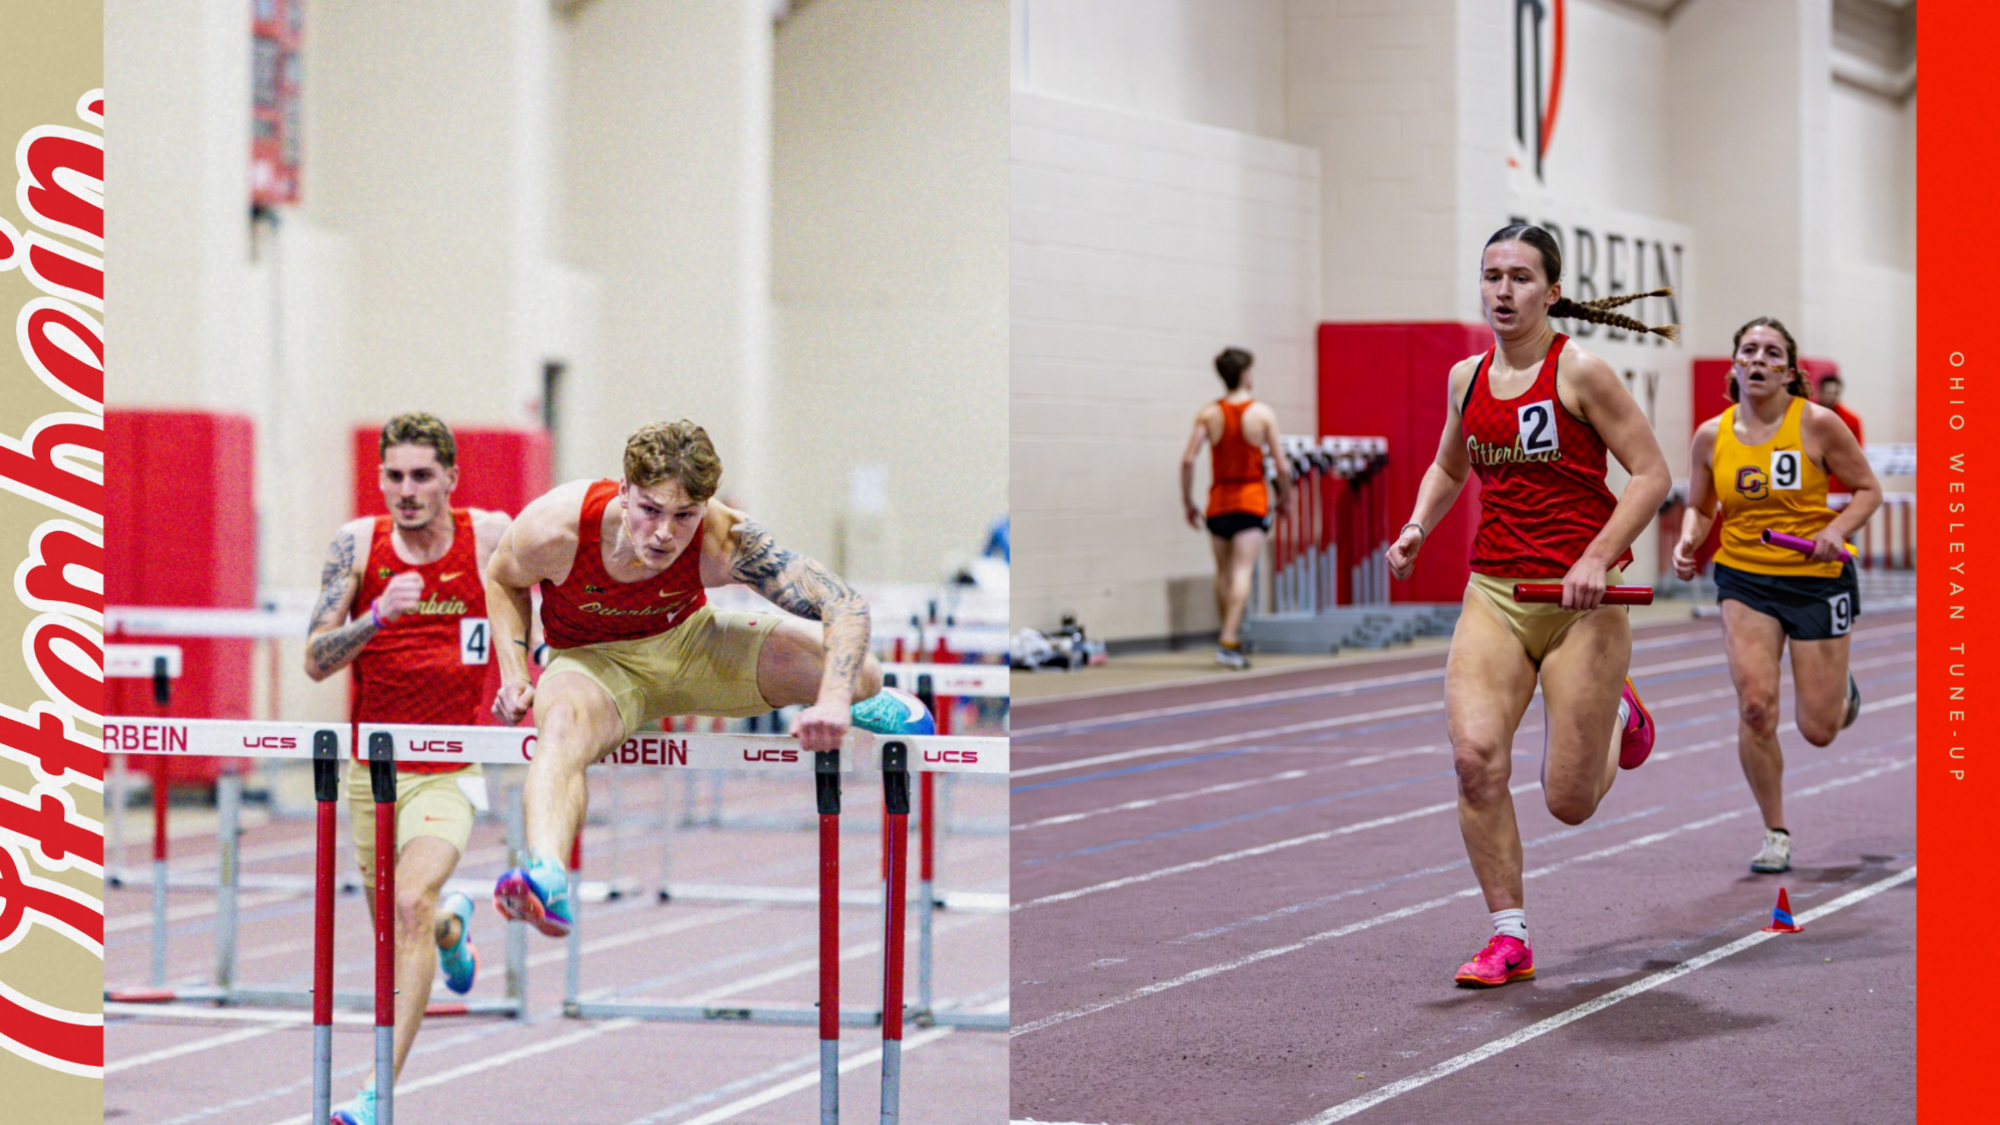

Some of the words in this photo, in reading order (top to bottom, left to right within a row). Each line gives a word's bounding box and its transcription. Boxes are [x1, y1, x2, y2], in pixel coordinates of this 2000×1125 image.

[1522, 405, 1553, 451] 2
[1776, 453, 1797, 487] 9
[1835, 596, 1850, 631] 9
[466, 622, 486, 660] 4
[243, 736, 297, 750] UCS
[409, 739, 464, 753] UCS
[744, 749, 799, 763] UCS
[923, 750, 979, 764] UCS
